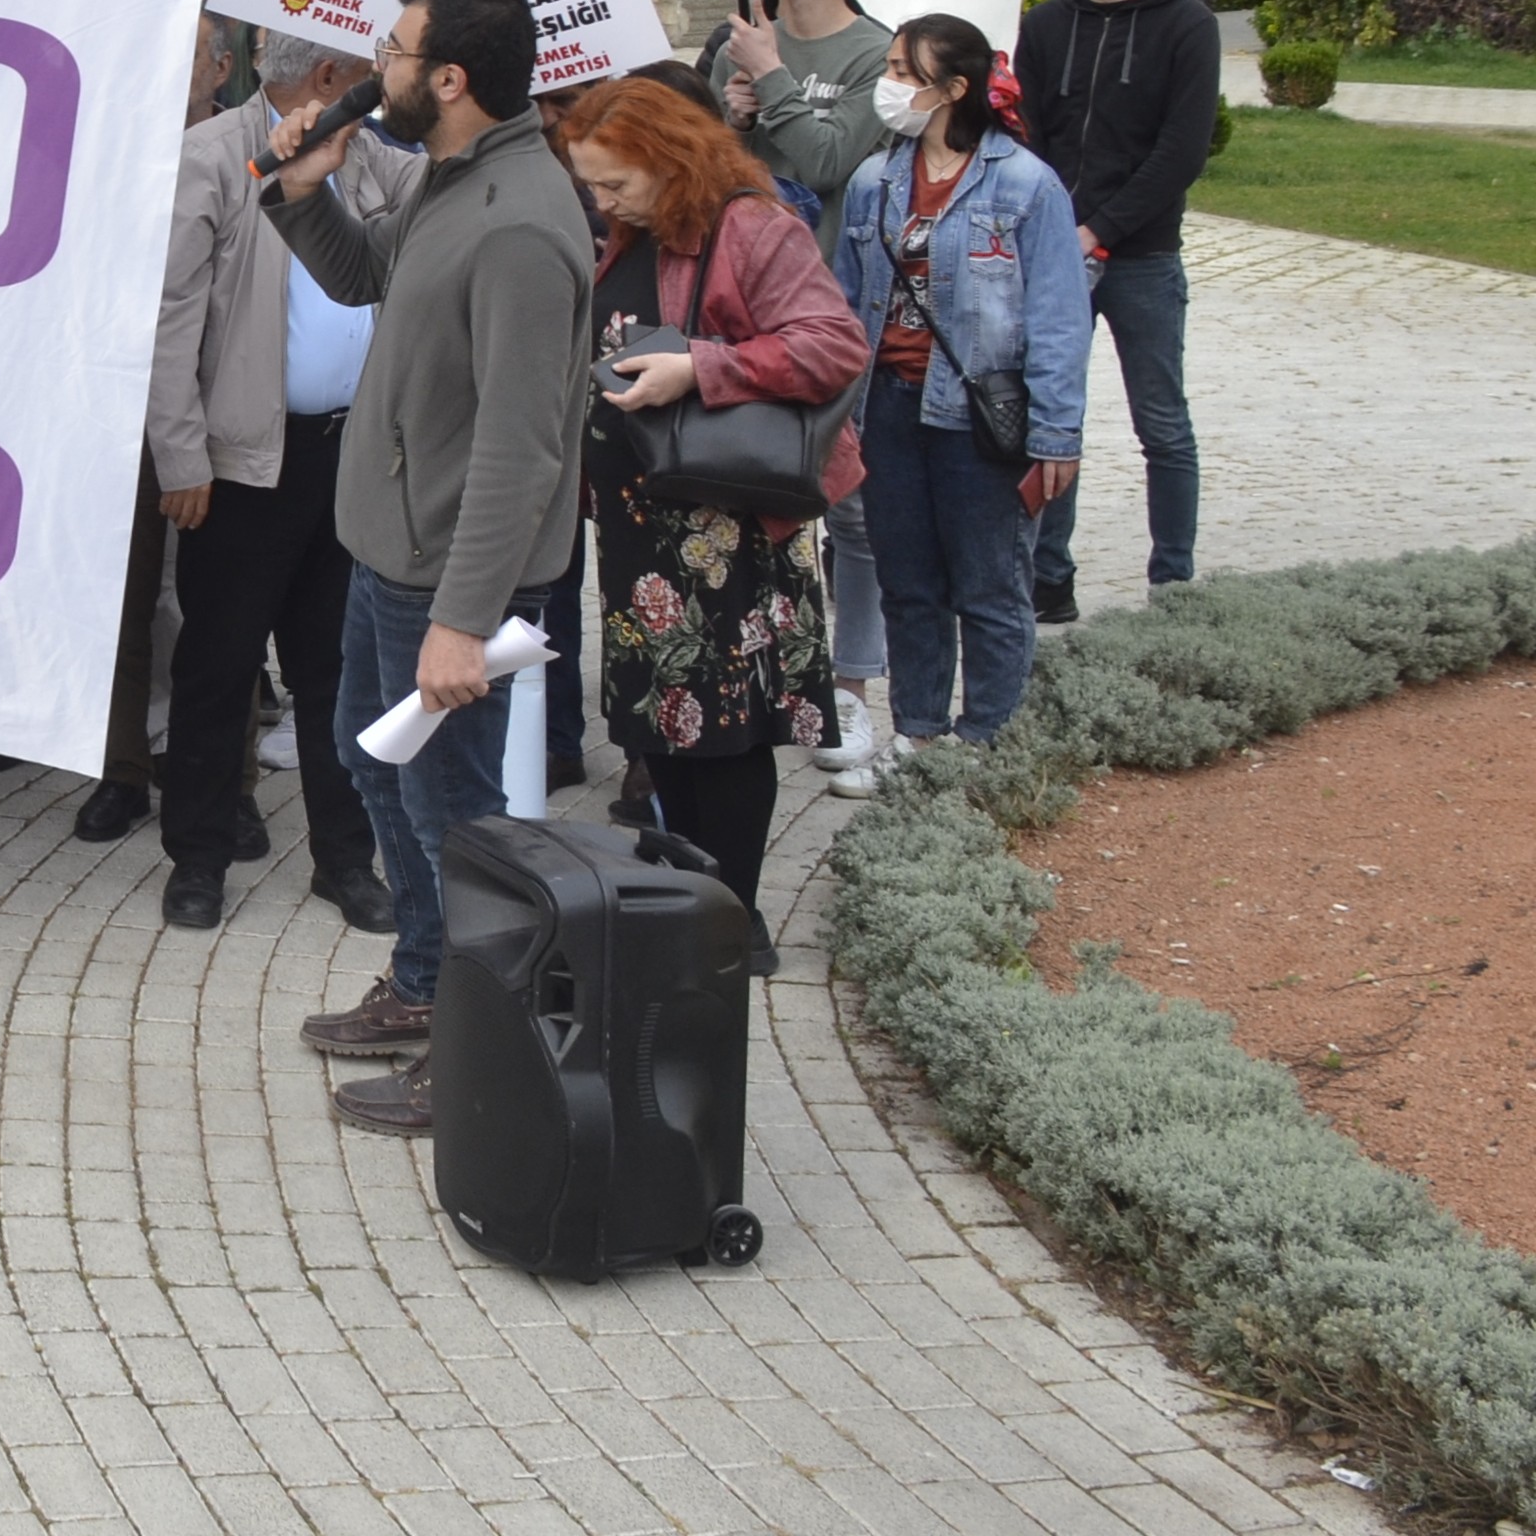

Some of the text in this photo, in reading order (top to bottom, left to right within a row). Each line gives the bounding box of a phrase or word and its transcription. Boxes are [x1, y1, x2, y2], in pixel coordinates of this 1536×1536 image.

[311, 7, 374, 36] PARTİSİ
[536, 42, 584, 66] EMEK
[540, 51, 612, 83] PARTİSİ
